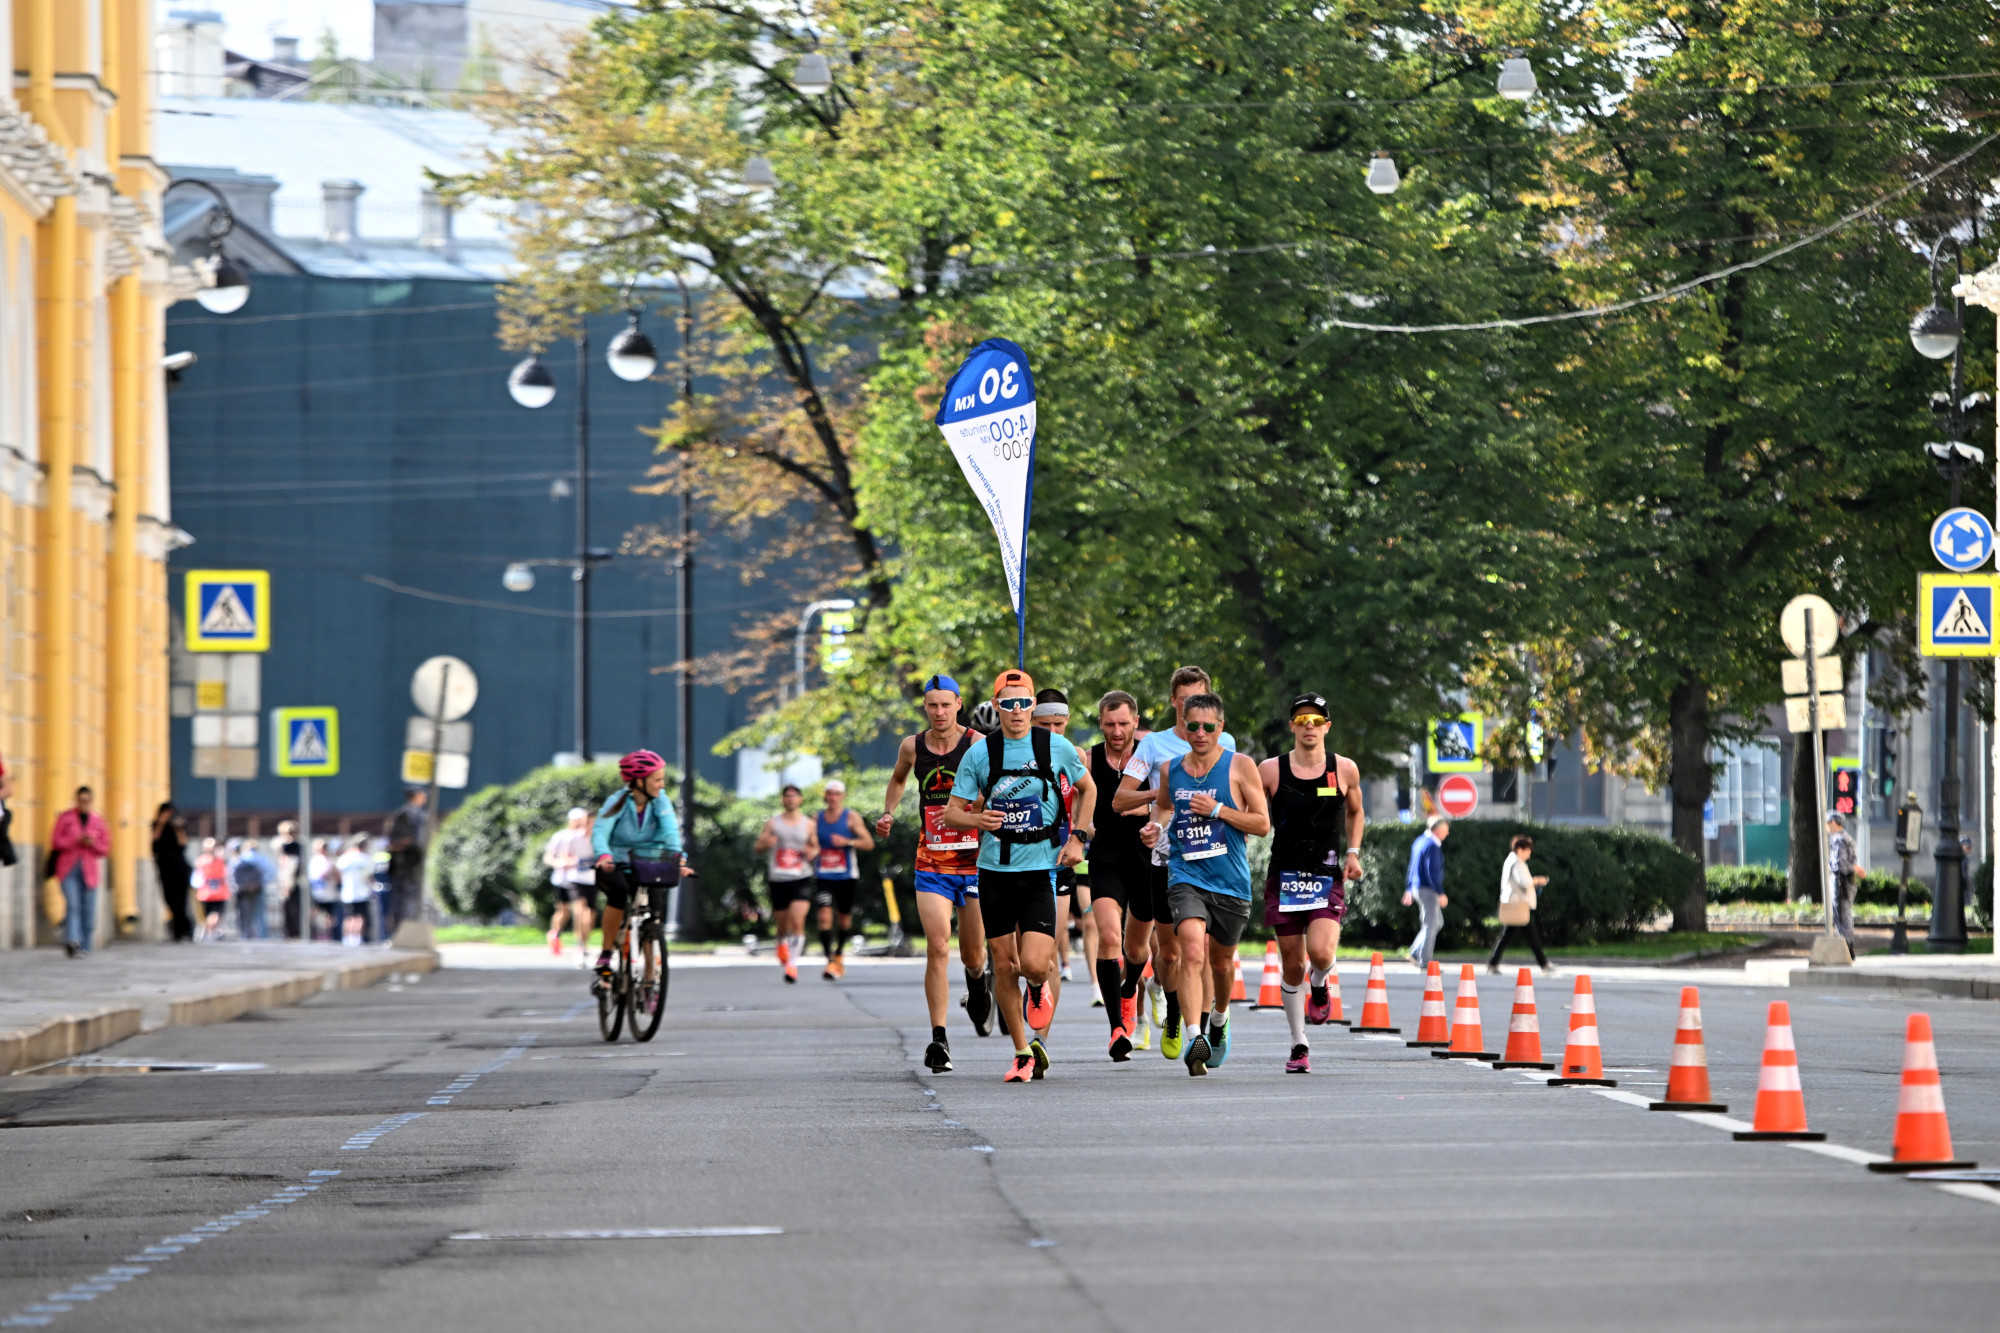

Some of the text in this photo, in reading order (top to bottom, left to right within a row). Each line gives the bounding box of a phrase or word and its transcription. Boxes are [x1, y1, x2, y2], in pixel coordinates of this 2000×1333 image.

[1002, 810, 1031, 823] 3897
[1186, 825, 1212, 839] 3114
[1290, 881, 1322, 892] 3940
